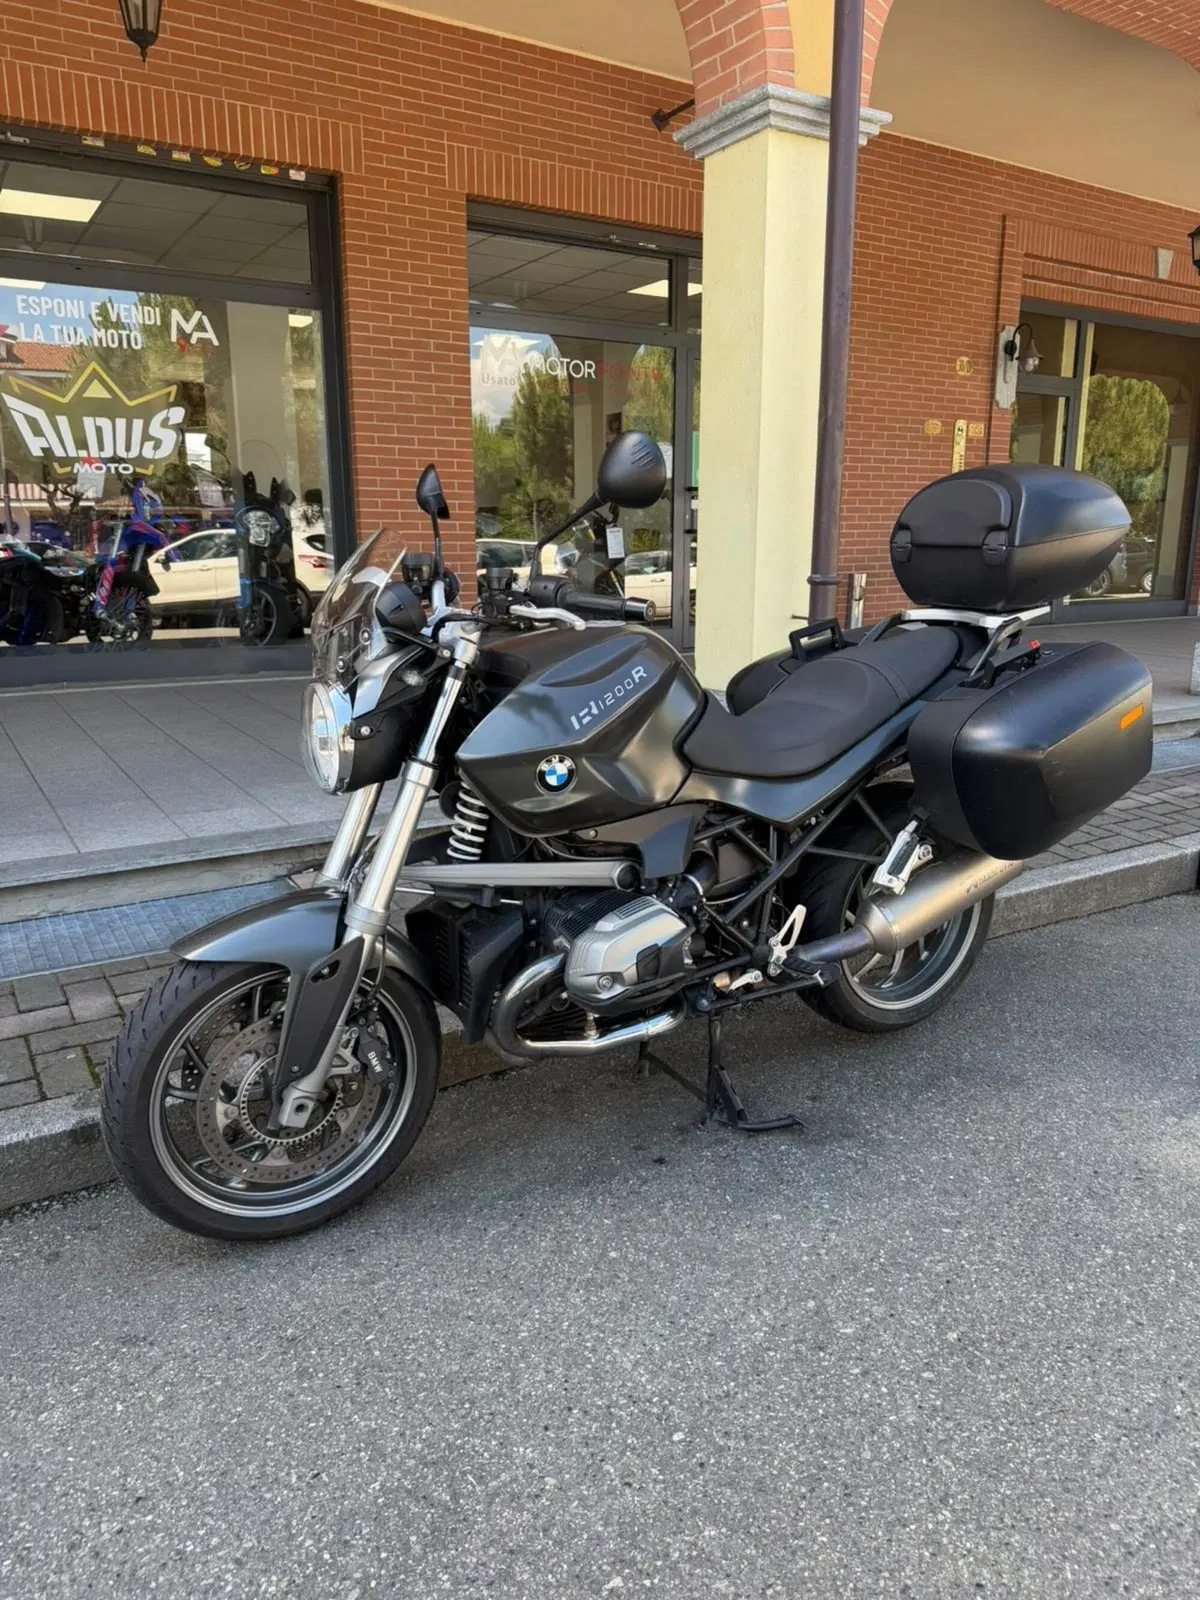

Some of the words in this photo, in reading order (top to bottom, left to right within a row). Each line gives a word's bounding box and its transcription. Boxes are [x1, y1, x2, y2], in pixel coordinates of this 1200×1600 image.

[16, 294, 86, 320] ESPONI
[91, 302, 103, 322] E
[105, 302, 162, 327] VENDI
[19, 322, 45, 343] LA
[50, 324, 89, 347] TUA
[93, 328, 143, 350] MOTO
[482, 372, 518, 387] Usato
[1, 392, 186, 460] ALDUS
[73, 462, 135, 475] MOTO
[540, 754, 573, 771] BMW
[367, 1051, 384, 1073] BMW
